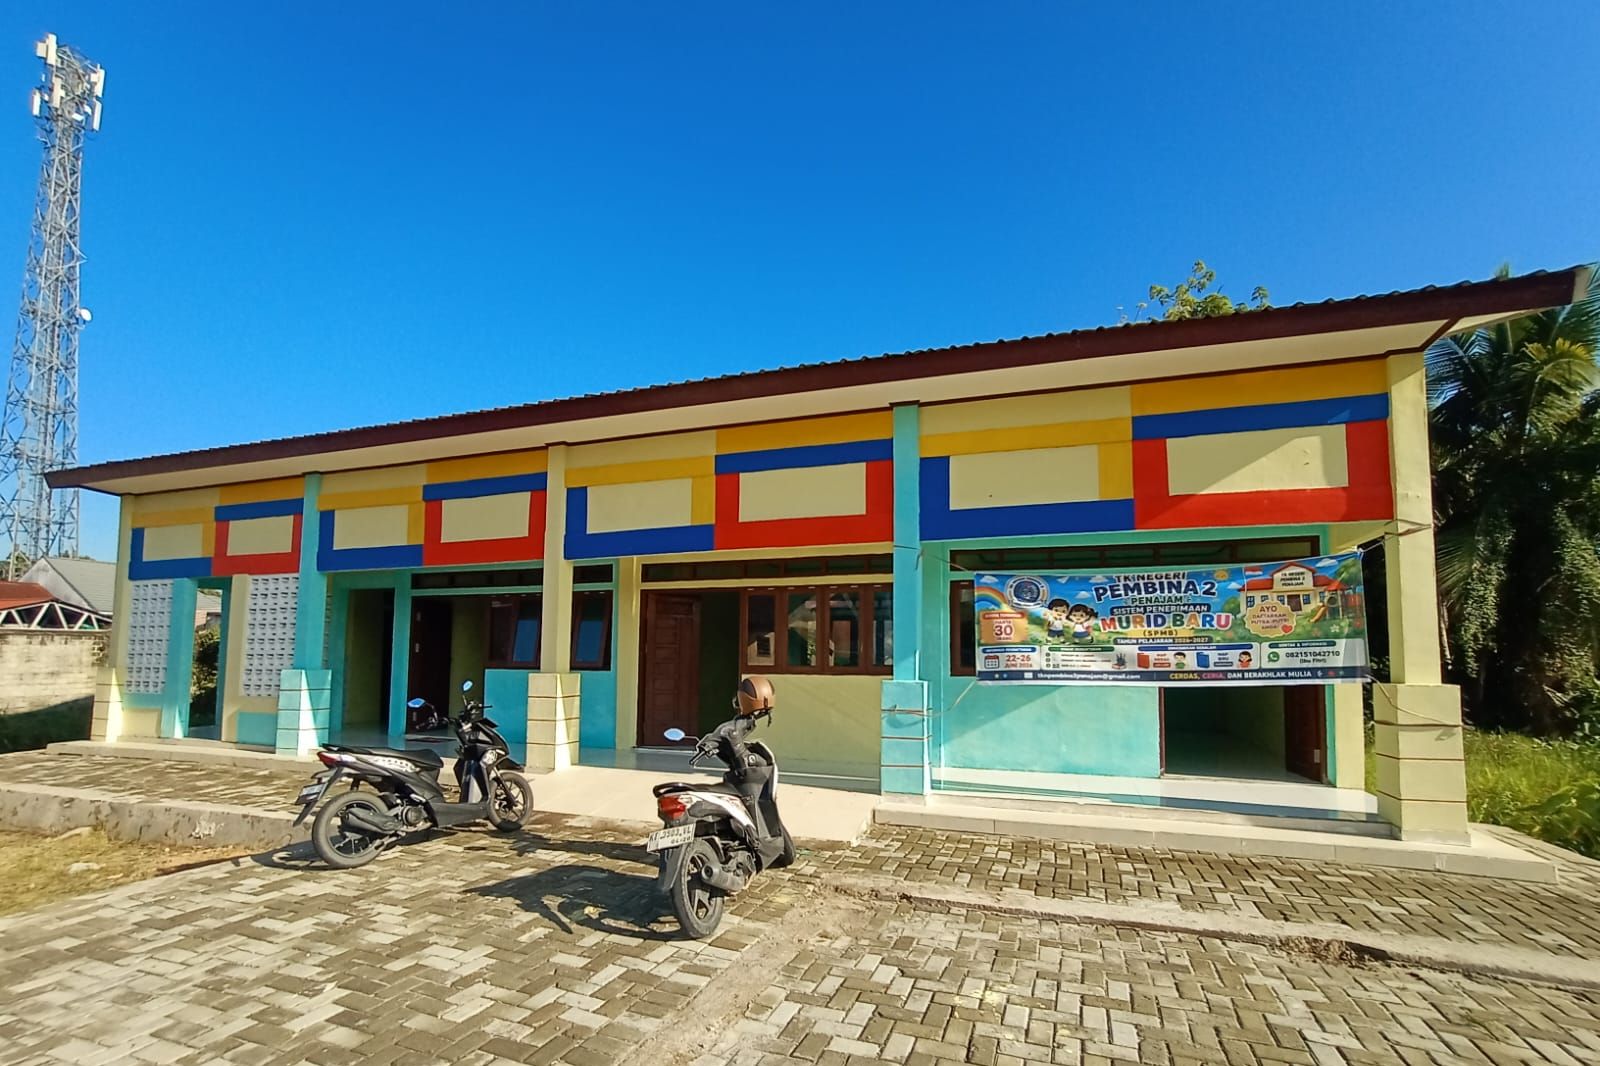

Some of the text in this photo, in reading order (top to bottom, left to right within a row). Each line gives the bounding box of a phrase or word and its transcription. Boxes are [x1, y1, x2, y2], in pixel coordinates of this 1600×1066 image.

[1115, 572, 1186, 583] TK NEGERI
[1093, 580, 1217, 602] PEMBINA 2
[1131, 595, 1184, 605] PENAJAM
[1113, 605, 1208, 615] SISTEM PENERIMAAN
[1100, 613, 1232, 631] MURID BARU
[994, 624, 1013, 637] 30
[1143, 629, 1179, 637] (SPMB)
[1227, 671, 1243, 679] DAN
[1244, 670, 1287, 679] BERAKHLAK
[1288, 670, 1312, 678] MULIA
